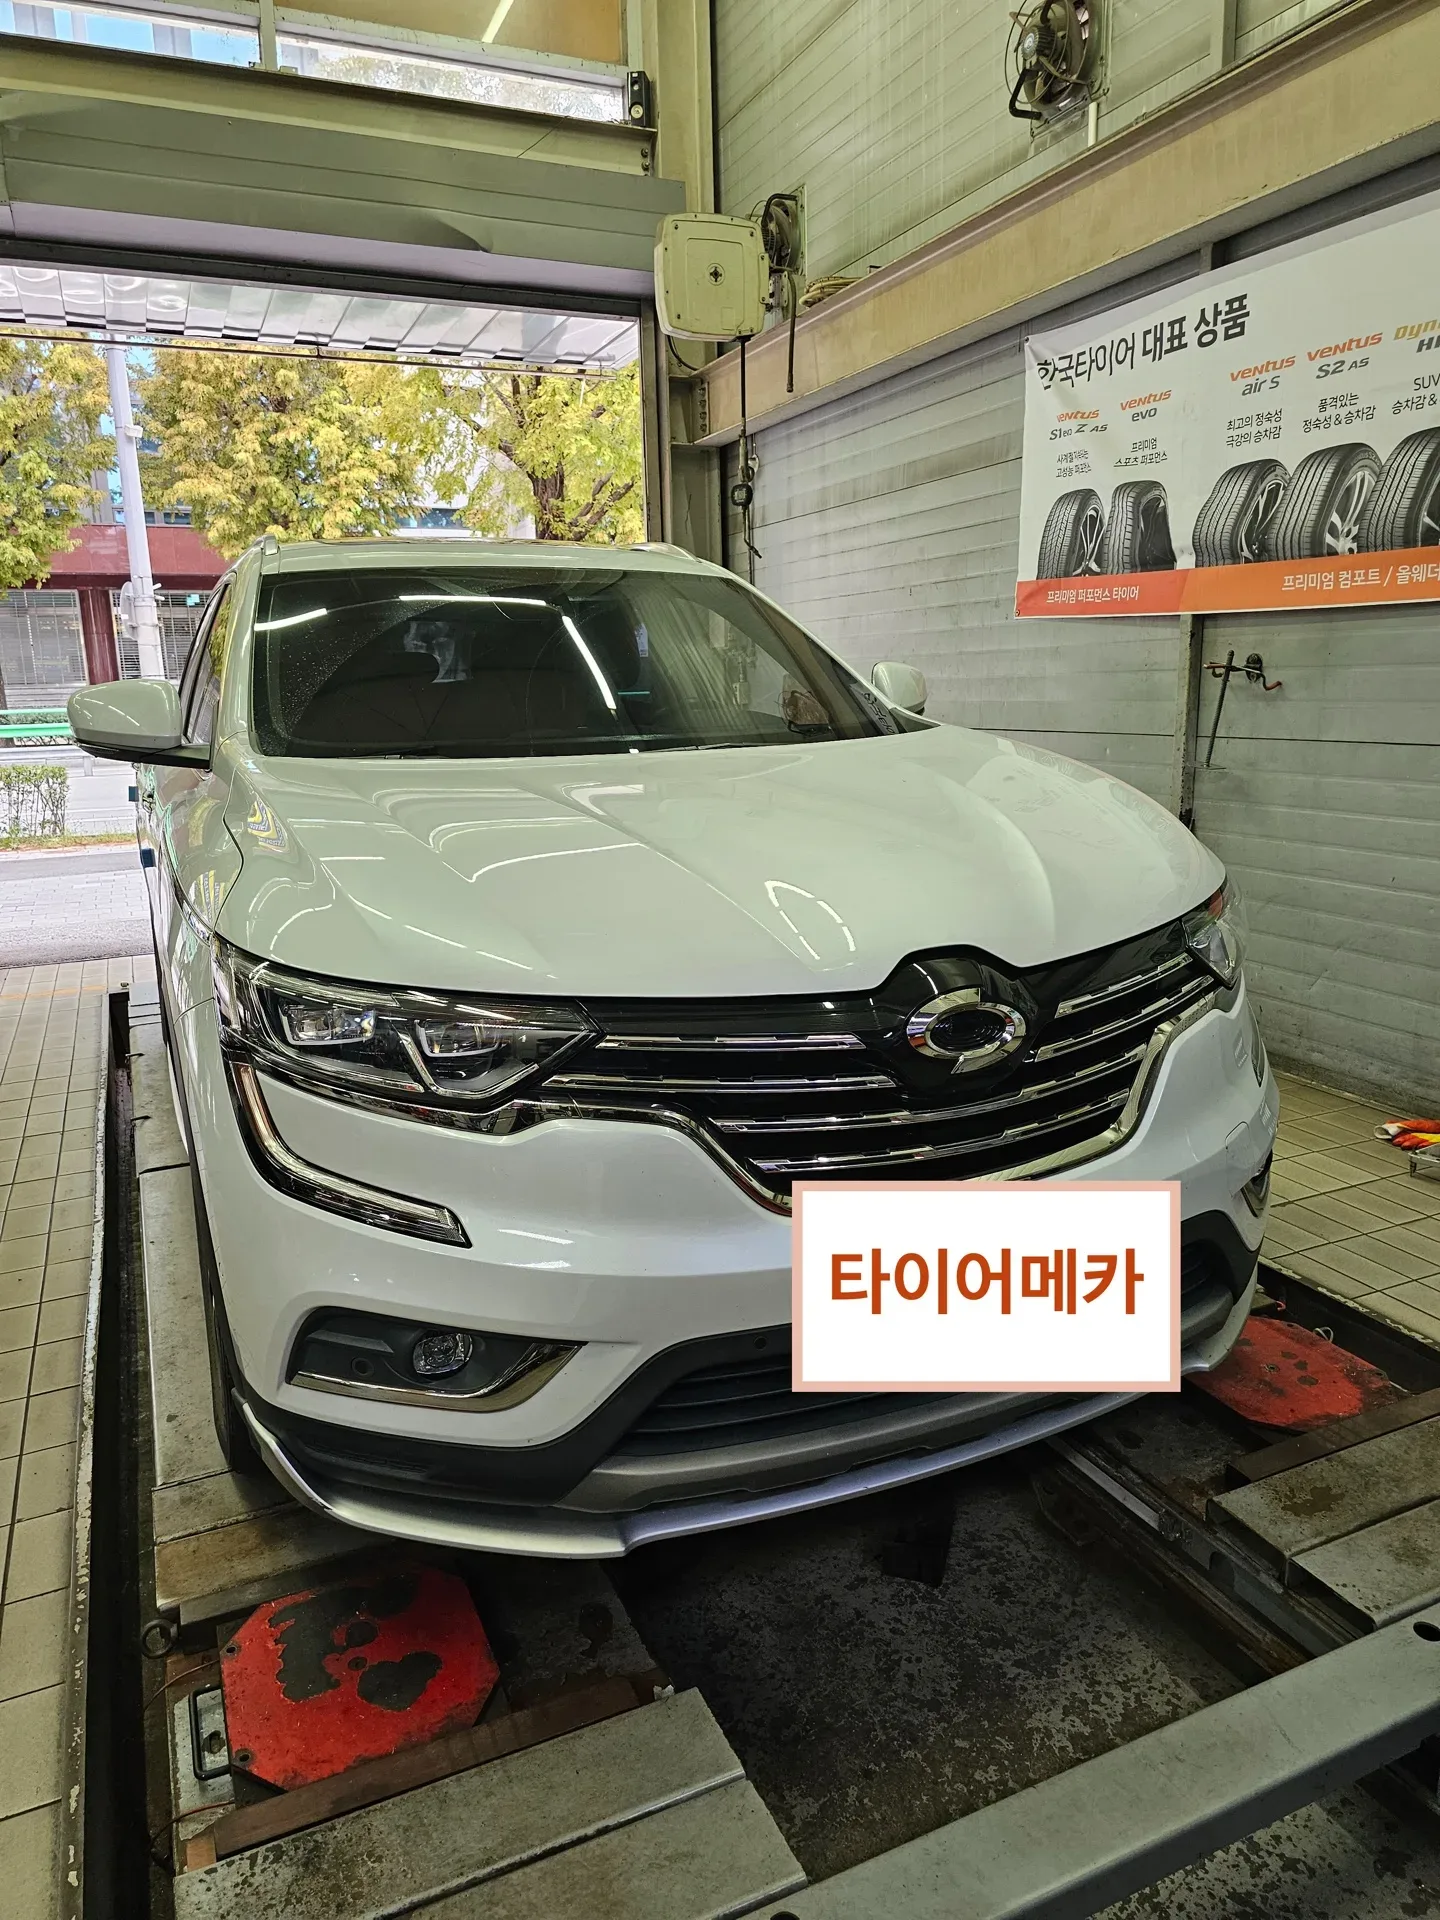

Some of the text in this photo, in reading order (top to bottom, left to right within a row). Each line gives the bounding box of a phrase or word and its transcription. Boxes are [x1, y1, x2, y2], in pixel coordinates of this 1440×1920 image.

[1394, 319, 1440, 340] Dyn
[1037, 294, 1250, 390] 한국타이어 대표 상품
[1315, 357, 1370, 379] S2 AS
[1241, 375, 1281, 396] air S
[1317, 392, 1360, 414] 품격있는
[1391, 393, 1438, 415] 승차감 &
[1131, 407, 1157, 422] evo
[1226, 408, 1283, 432] 최고의 정숙성
[1302, 404, 1377, 434] 정숙성 & 승차감
[1074, 423, 1089, 434] Z
[1089, 423, 1109, 433] AS
[1225, 426, 1282, 448] 극강의 승차감
[1131, 437, 1158, 453] 프리미엄
[1113, 451, 1168, 468] 스포츠 퍼포먼스
[1282, 571, 1334, 592] 프리미엄
[1338, 567, 1381, 589] 컴포트
[1396, 562, 1440, 586] 올웨더
[1047, 586, 1140, 604] 프리미엄 퍼포먼스 타이어
